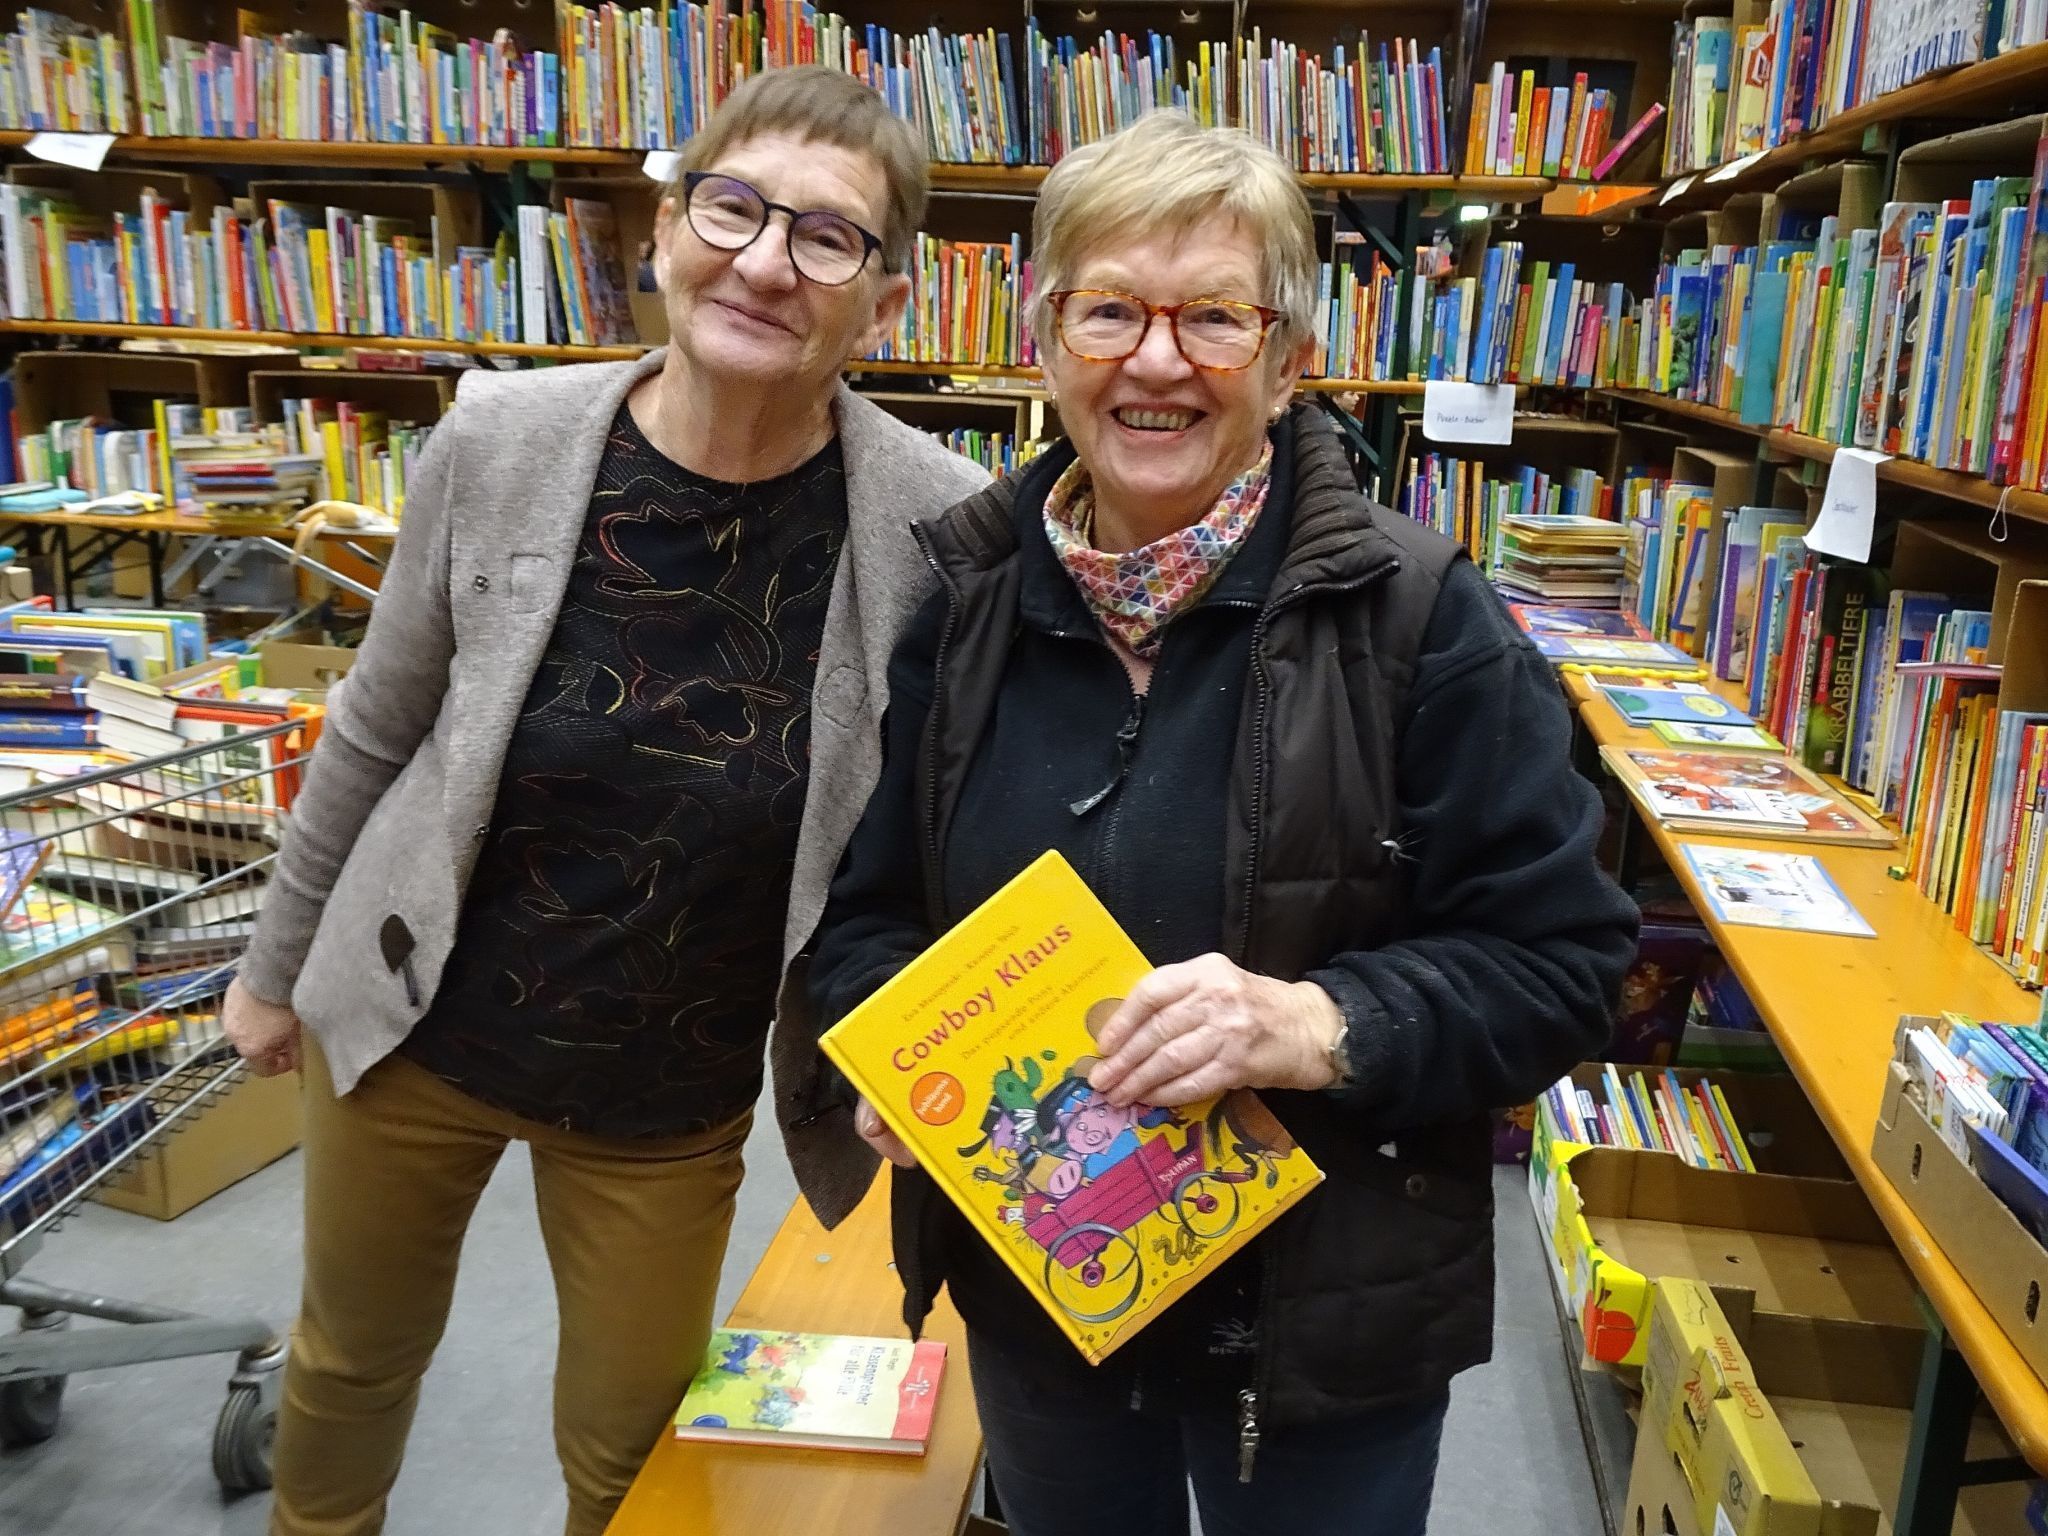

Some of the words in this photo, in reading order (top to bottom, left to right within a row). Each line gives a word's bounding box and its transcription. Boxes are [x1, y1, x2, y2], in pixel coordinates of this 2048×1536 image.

[1827, 592, 1864, 743] KRABBELTIERE
[893, 986, 996, 1072] Cowboy
[995, 924, 1071, 988] Klaus
[1714, 1335, 1741, 1373] Fruits
